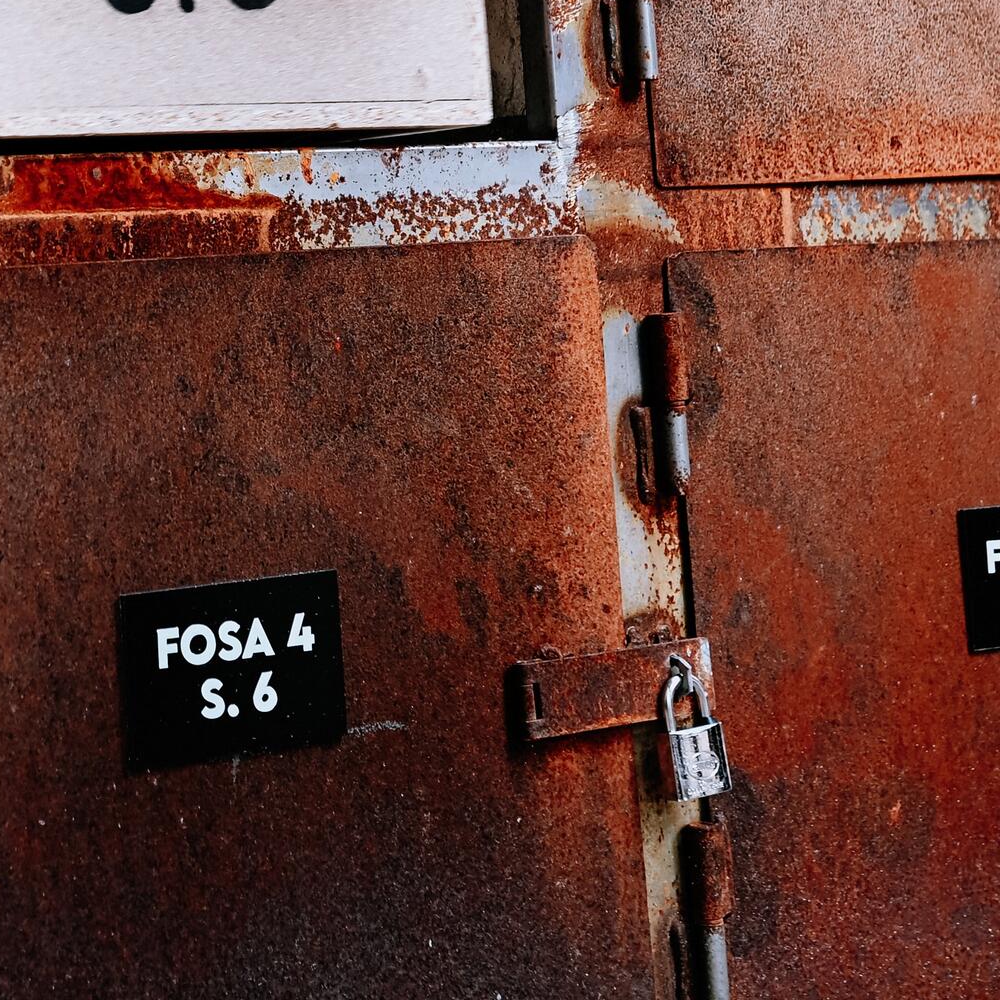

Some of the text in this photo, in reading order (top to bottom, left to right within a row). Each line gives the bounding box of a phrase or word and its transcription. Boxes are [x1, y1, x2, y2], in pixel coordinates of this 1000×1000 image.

[156, 612, 316, 670] FOSA 4
[201, 671, 278, 720] S. 6
